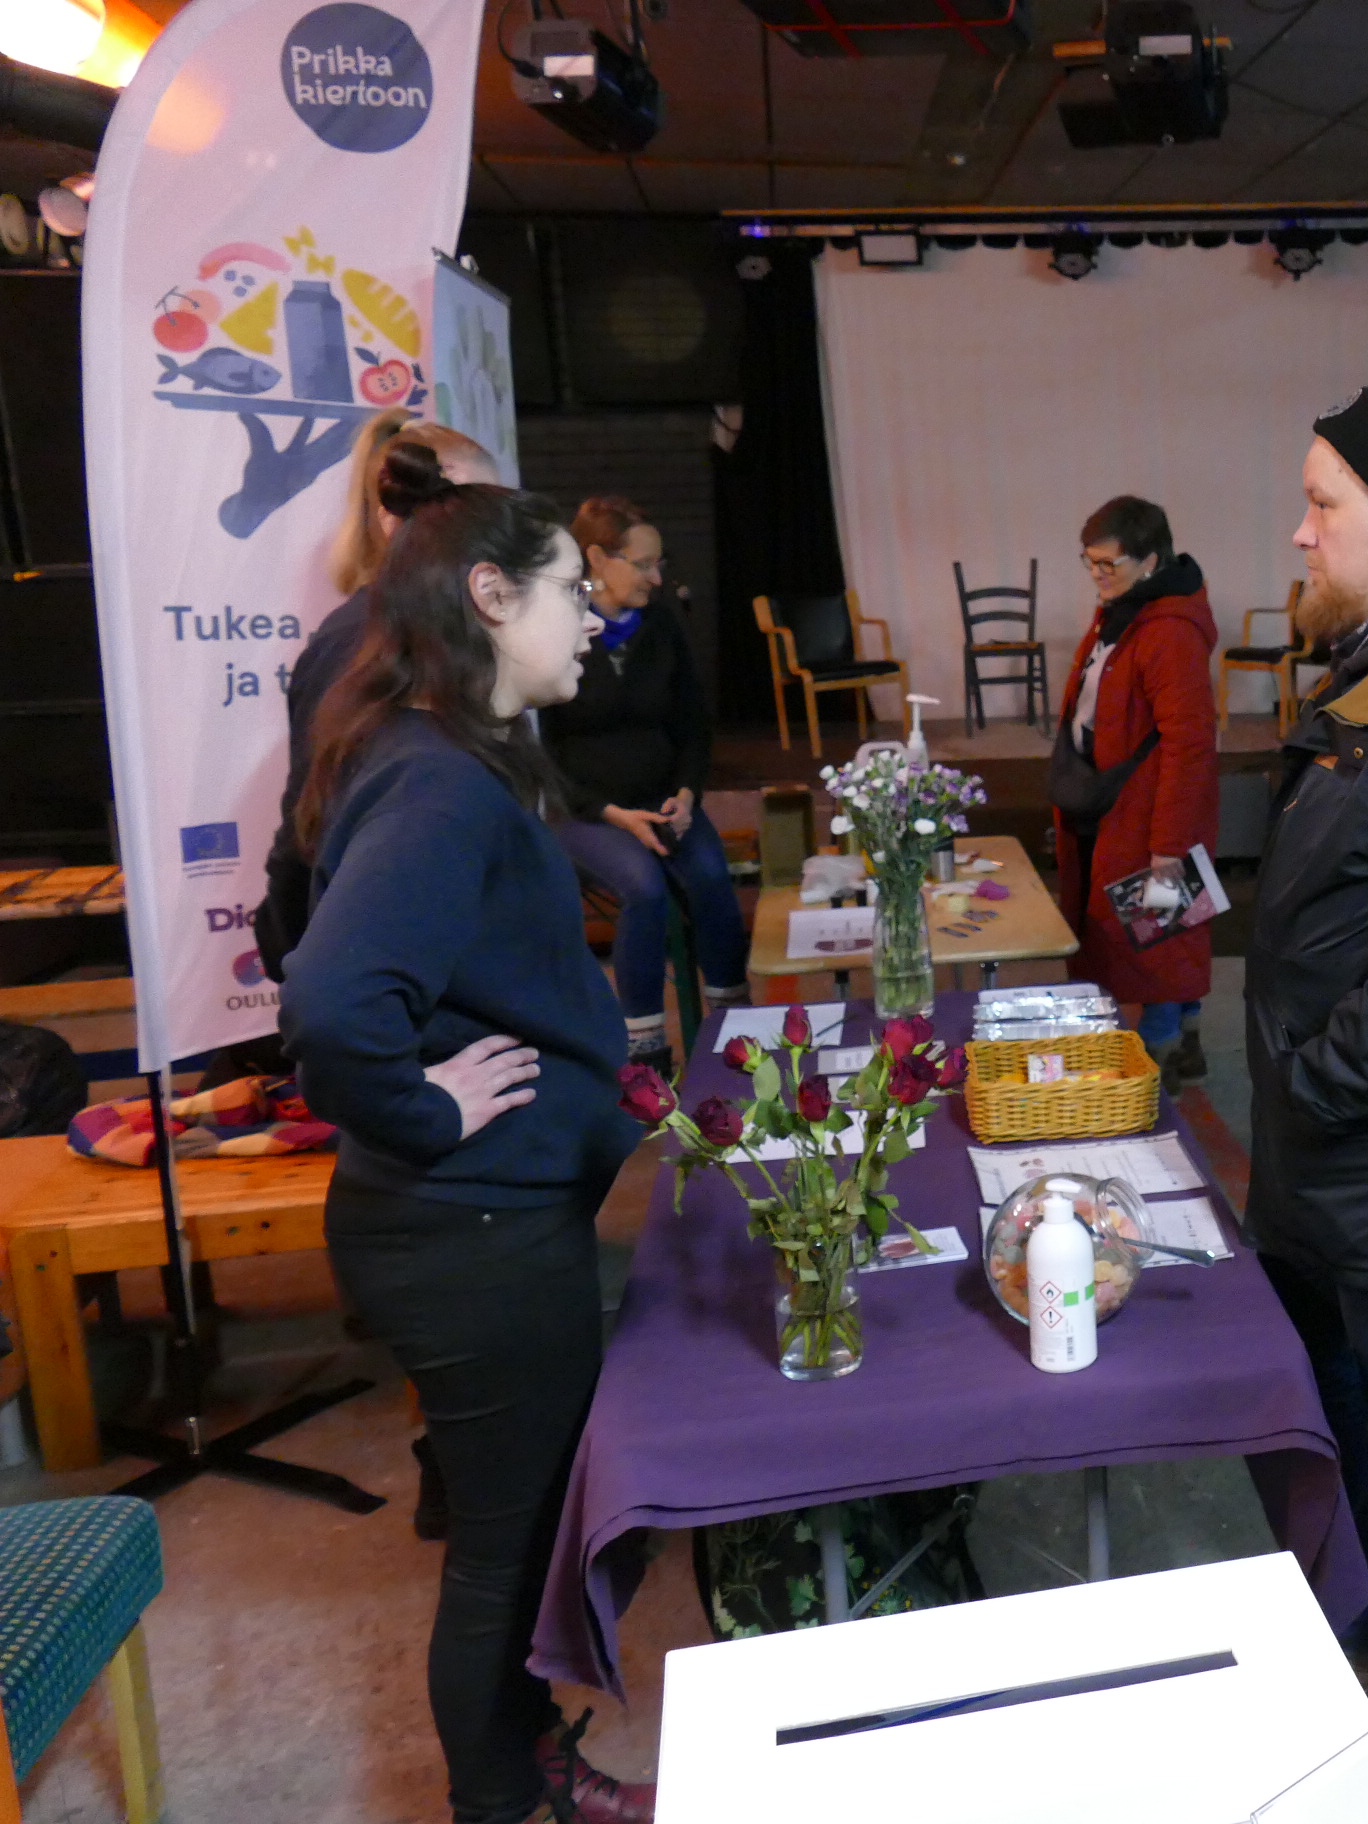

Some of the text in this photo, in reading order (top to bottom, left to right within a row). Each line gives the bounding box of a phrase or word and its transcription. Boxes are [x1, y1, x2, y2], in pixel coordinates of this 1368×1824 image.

[290, 44, 393, 77] Prikka
[293, 73, 427, 109] kiertoon
[162, 604, 302, 641] Tukea
[222, 662, 260, 707] ja
